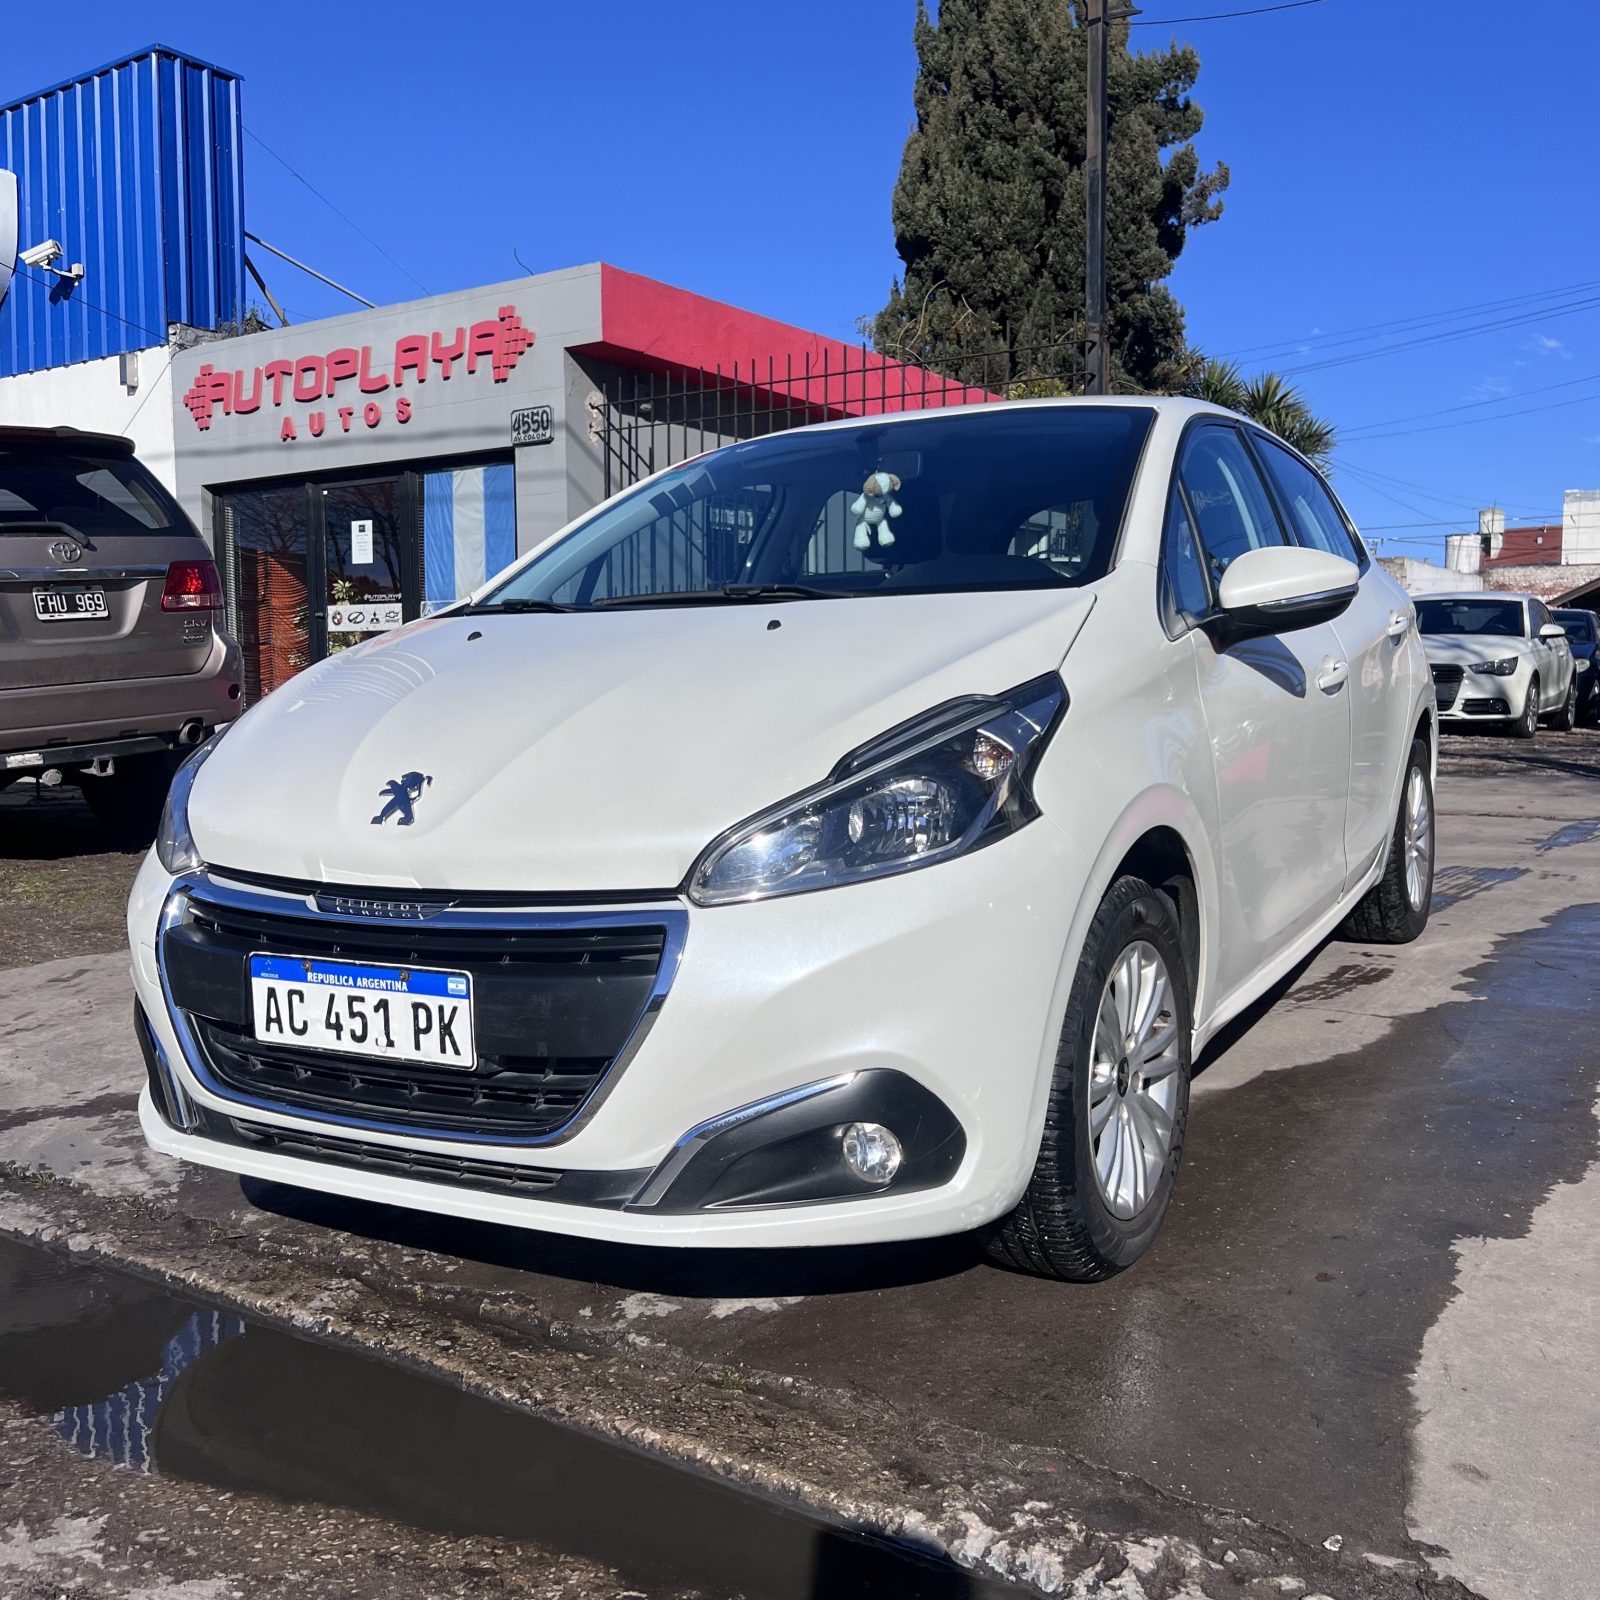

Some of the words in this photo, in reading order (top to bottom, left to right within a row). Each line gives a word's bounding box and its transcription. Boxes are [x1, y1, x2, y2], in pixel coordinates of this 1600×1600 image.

[205, 319, 508, 416] AUTOPLAYA
[281, 397, 412, 442] AUTOS
[513, 410, 549, 435] 4550
[37, 594, 67, 612] FHU
[76, 593, 105, 611] 969
[336, 898, 422, 911] PEUGEOT
[307, 971, 354, 987] REPUBLICA
[356, 977, 408, 991] ARGENTINA
[265, 986, 308, 1036] AC
[325, 992, 395, 1048] 451
[411, 1001, 462, 1056] PK
